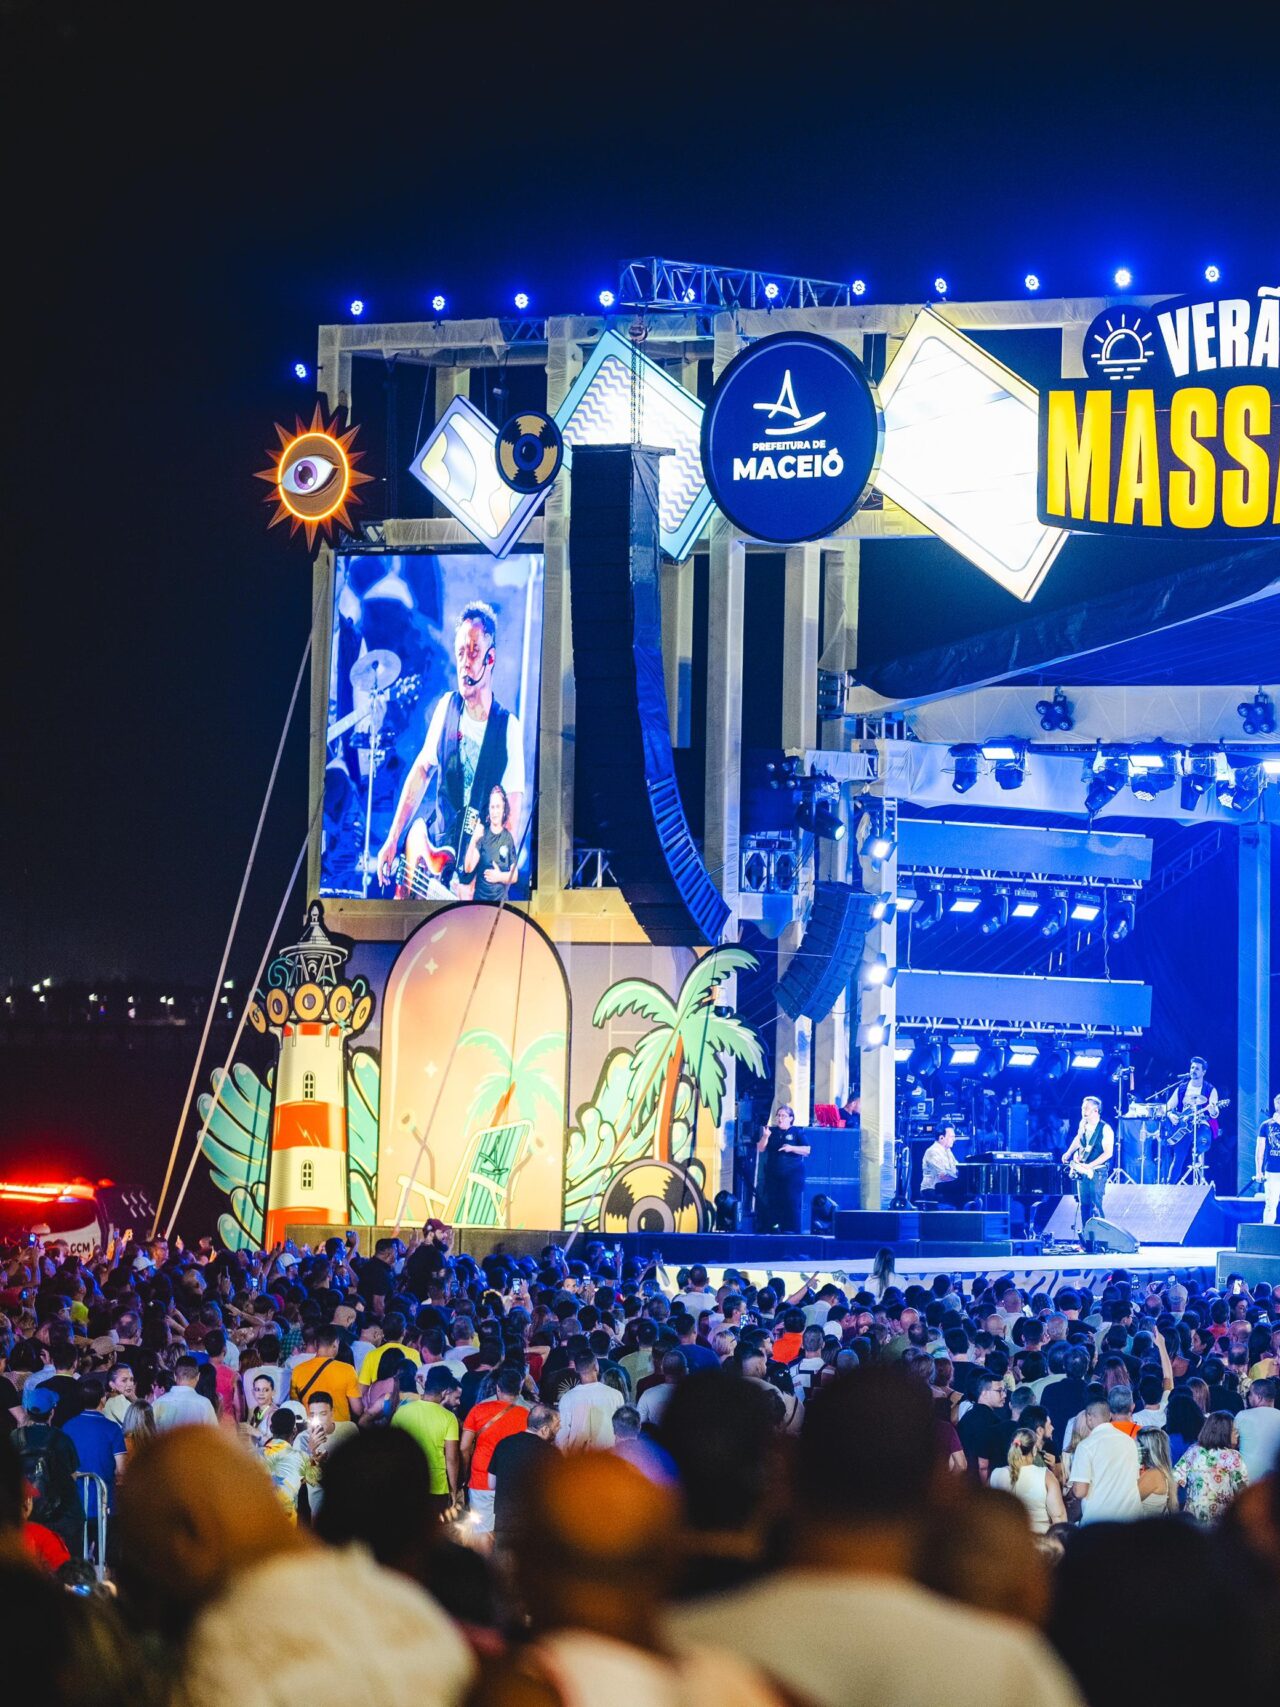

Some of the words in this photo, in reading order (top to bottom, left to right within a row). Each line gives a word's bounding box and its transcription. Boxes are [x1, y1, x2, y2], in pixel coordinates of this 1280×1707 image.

[752, 441, 810, 451] PREFEITURA
[812, 440, 826, 449] DE
[733, 448, 844, 481] MACEIÓ
[70, 1242, 90, 1253] GCM
